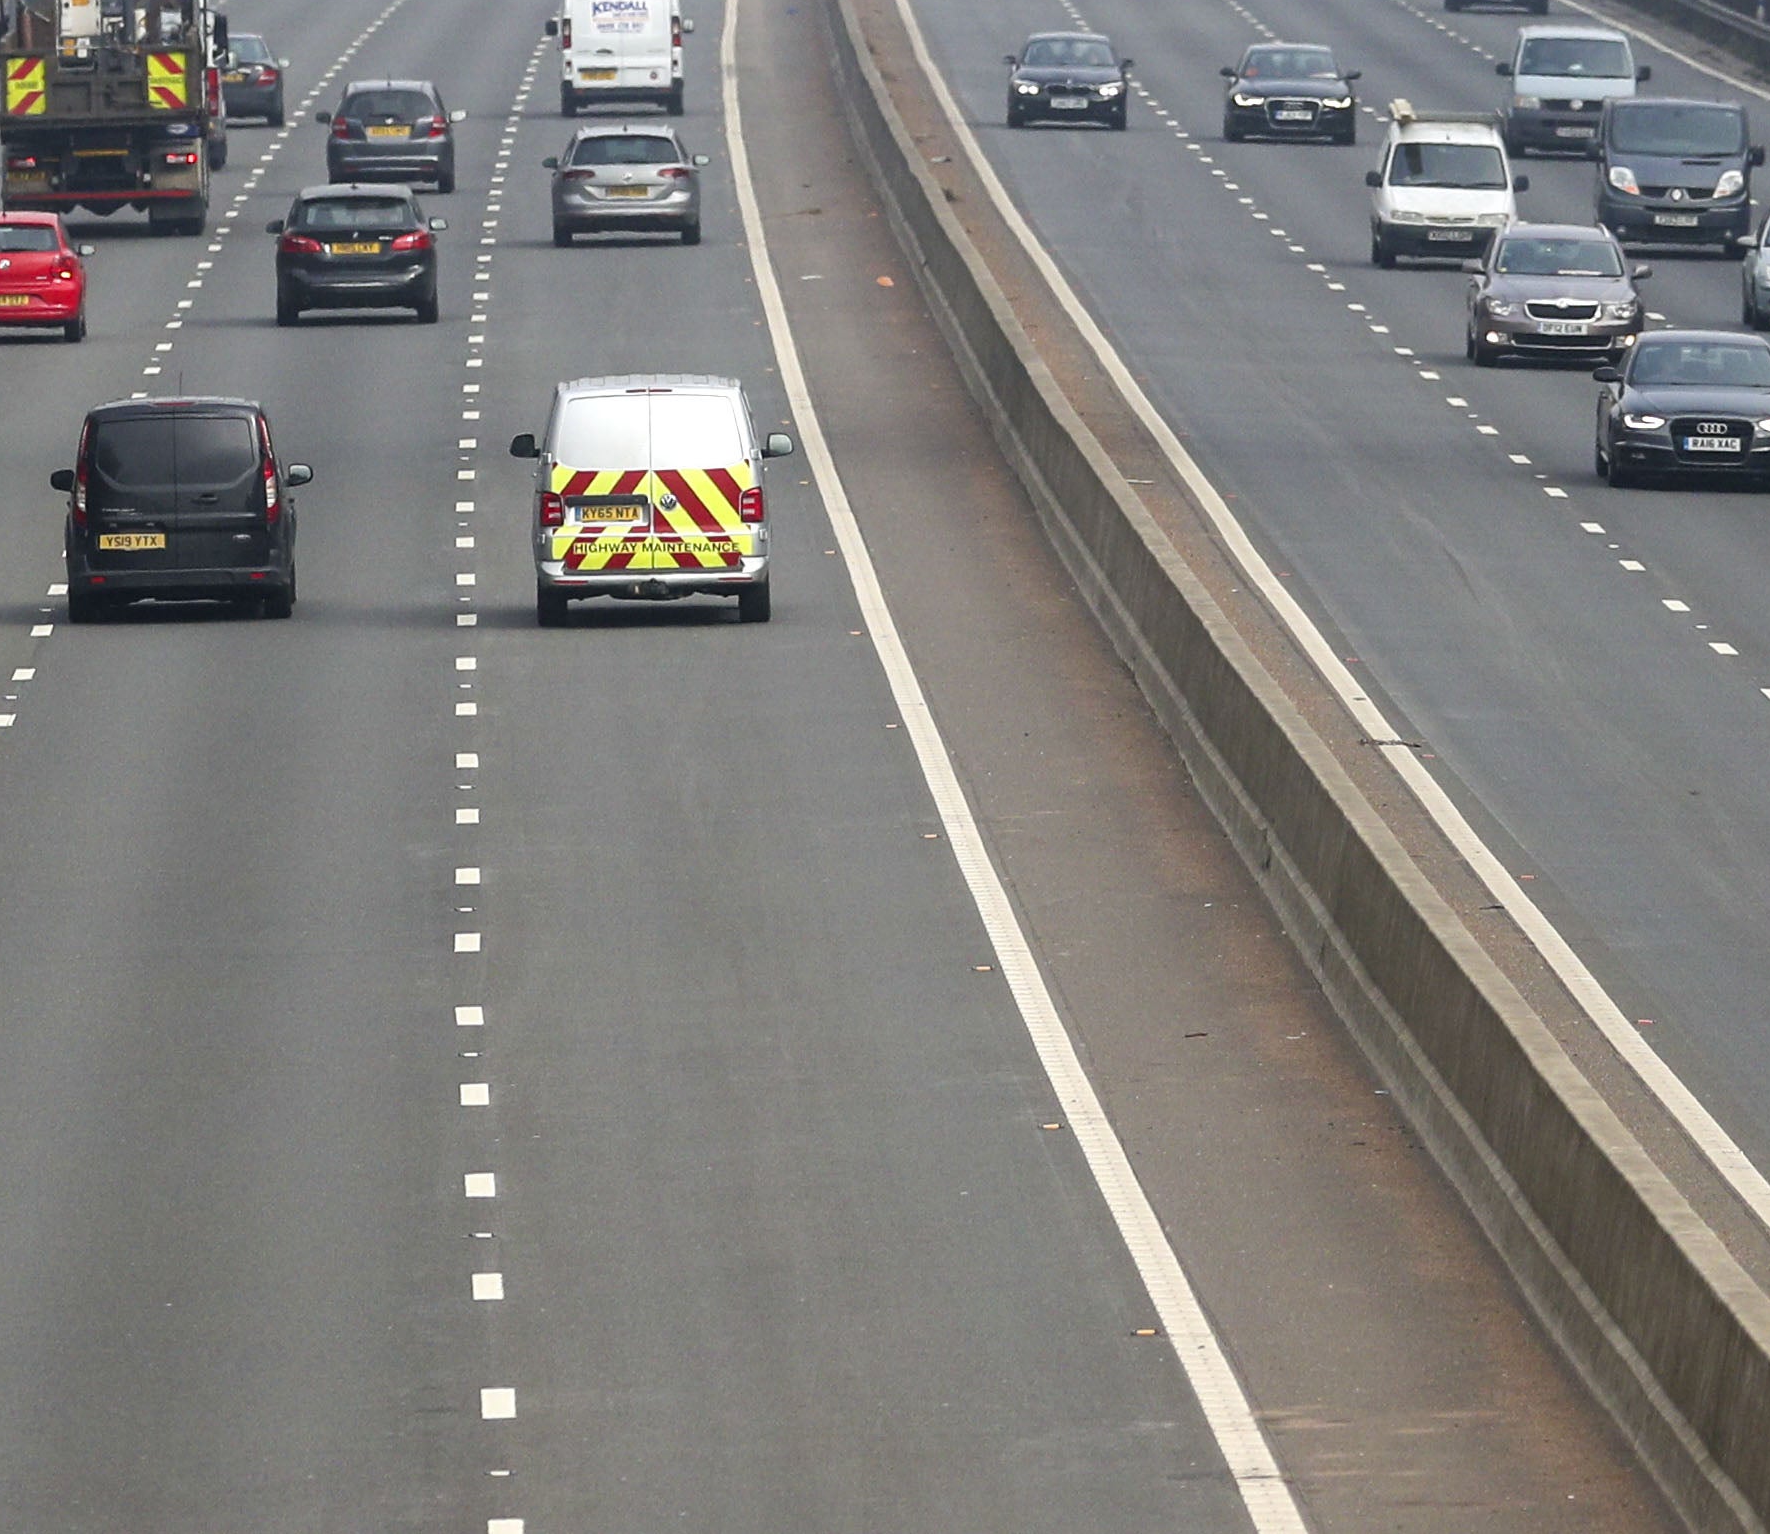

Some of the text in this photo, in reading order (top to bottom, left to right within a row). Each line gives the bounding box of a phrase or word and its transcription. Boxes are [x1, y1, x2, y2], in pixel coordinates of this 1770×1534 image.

[592, 0, 647, 17] KENDALL
[581, 506, 639, 519] KY65 NTA
[135, 535, 158, 547] YTX
[573, 542, 740, 553] HIGHWAY MAINTENANCE
